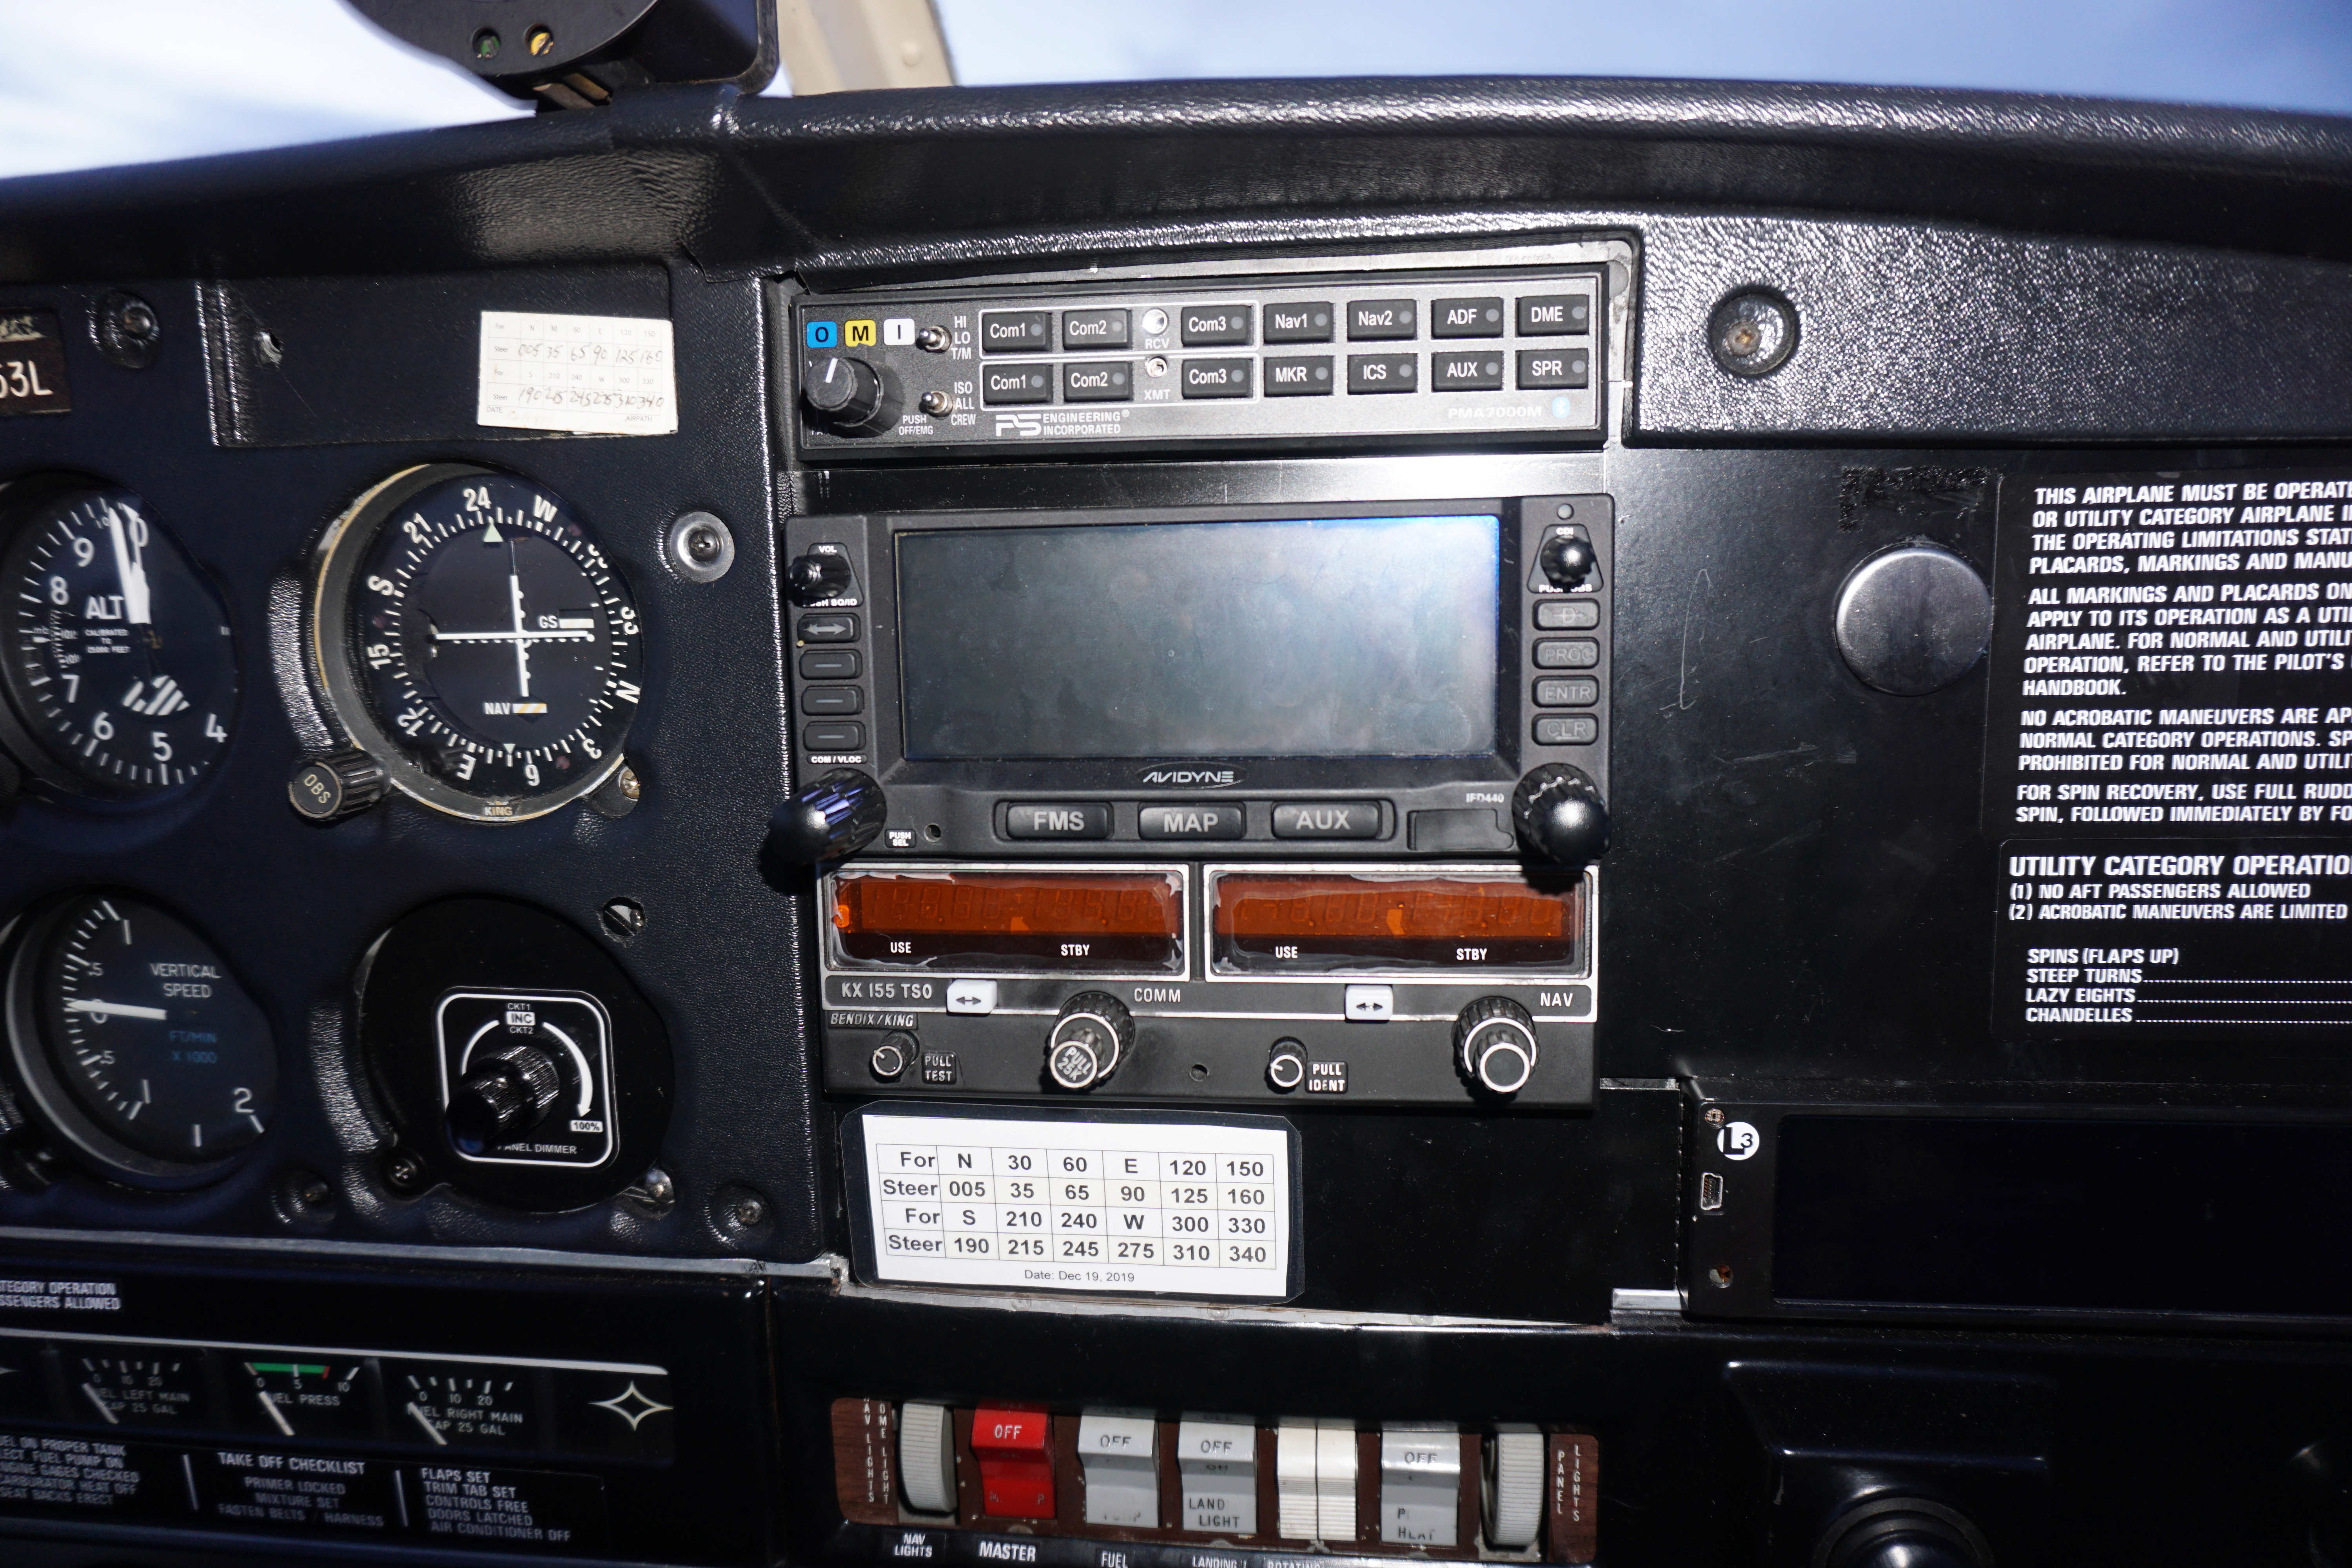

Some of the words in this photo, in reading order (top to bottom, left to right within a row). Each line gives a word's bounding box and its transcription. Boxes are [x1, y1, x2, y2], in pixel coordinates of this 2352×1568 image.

[1275, 314, 1307, 328] Nav1
[1358, 310, 1392, 326] Nav2
[1447, 309, 1477, 325] ADF
[1531, 307, 1563, 322] DME
[954, 317, 967, 328] HI
[1069, 320, 1106, 336] Com2
[1188, 317, 1227, 332] Com3
[815, 327, 829, 342] O
[852, 326, 869, 341] M
[898, 325, 901, 339] I
[955, 332, 970, 343] LO
[990, 323, 1026, 338] Com1
[1145, 338, 1170, 349] RCV
[951, 348, 971, 360] T/M
[1275, 367, 1307, 382] MKR
[1363, 365, 1387, 380] ICS
[1447, 361, 1477, 377] AUX
[1532, 361, 1562, 376] SPR
[991, 375, 1027, 390] Com1
[1070, 372, 1108, 388] Com2
[1189, 368, 1227, 385] Com3
[954, 382, 973, 394] ISO
[1144, 389, 1171, 400] XMT
[955, 398, 974, 410] ALL
[902, 415, 926, 424] PUSH
[951, 414, 976, 425] CREW
[1448, 406, 1541, 419] PMA7000M
[898, 426, 933, 435] OFF/EMG
[1043, 424, 1120, 436] INCORPORATED
[463, 487, 491, 512] 24
[2035, 488, 2076, 505] THIS
[2082, 485, 2174, 505] AIRPLANE
[2181, 485, 2238, 501] MUST
[2243, 483, 2268, 500] BE
[403, 513, 432, 543] 21
[73, 537, 94, 567] 9
[86, 595, 124, 619] ALT
[539, 616, 557, 627] GS
[1545, 648, 1594, 661] PROC
[1545, 687, 1591, 700] ENTR
[485, 703, 510, 715] NAV
[1547, 723, 1586, 735] CLR
[1143, 771, 1234, 782] AVIDYNE
[304, 774, 331, 804] OBS
[2017, 785, 2051, 800] FOR
[2057, 785, 2099, 800] SPIN
[2107, 785, 2204, 801] RECOVERY,
[2211, 784, 2247, 799] USE
[2254, 784, 2297, 799] FULL
[1466, 793, 1504, 802] IFD440
[485, 807, 512, 816] KING
[1034, 811, 1084, 831] FMS
[1164, 813, 1218, 832] MAP
[1296, 810, 1350, 829] AUX
[2009, 857, 2096, 876] UTILITY
[2104, 856, 2225, 875] CATEGORY
[2010, 884, 2032, 900] (1)
[2038, 884, 2063, 898] NO
[2069, 884, 2102, 898] AFT
[2108, 884, 2221, 898] PASSENGERS
[2227, 883, 2311, 898] ALLOWED
[890, 942, 911, 953] USE
[1061, 945, 1089, 956] STBY
[1275, 947, 1298, 958] USE
[1456, 948, 1487, 961] STBY
[150, 963, 221, 978] VERTICAL
[2027, 969, 2078, 983] STEEP
[2086, 969, 2142, 983] TURNS
[163, 984, 211, 998] SPEED
[842, 983, 862, 998] KX
[869, 984, 894, 998] 155
[901, 984, 932, 999] TSO
[1134, 988, 1181, 1003] COMM
[2025, 989, 2070, 1002] LAZY
[2076, 989, 2136, 1002] EIGHTS
[1540, 992, 1573, 1007] NAV
[510, 1013, 532, 1024] INC
[2025, 1008, 2132, 1022] CHANDELLES
[925, 1055, 951, 1067] PULL
[1064, 1046, 1090, 1075] PULL
[925, 1070, 951, 1082] TEST
[1057, 1058, 1080, 1081] 25K
[1312, 1064, 1341, 1076] PULL
[1309, 1079, 1345, 1091] IDENT
[573, 1122, 600, 1131] 100%
[901, 1151, 935, 1169] For
[958, 1154, 971, 1169] N
[1008, 1155, 1032, 1170] 30
[1063, 1156, 1087, 1172] 60
[1125, 1158, 1138, 1173] E
[1170, 1160, 1207, 1176] 120
[1227, 1161, 1263, 1177] 150
[883, 1180, 938, 1198] Steer
[949, 1181, 985, 1198] 005
[1010, 1183, 1034, 1199] 35
[1065, 1184, 1089, 1201] 65
[1120, 1186, 1145, 1202] 90
[1171, 1187, 1208, 1204] 125
[1227, 1189, 1265, 1205] 160
[906, 1208, 940, 1225] For
[963, 1210, 976, 1226] S
[1006, 1211, 1042, 1228] 210
[1061, 1212, 1097, 1229] 240
[1123, 1215, 1144, 1230] W
[1172, 1216, 1209, 1233] 300
[1228, 1218, 1266, 1234] 330
[889, 1235, 942, 1253] Steer
[954, 1238, 990, 1254] 190
[1008, 1239, 1044, 1256] 215
[1063, 1241, 1099, 1258] 245
[1118, 1242, 1154, 1259] 275
[1172, 1244, 1210, 1261] 310
[1229, 1246, 1266, 1263] 340
[1024, 1270, 1054, 1281] Date:
[1058, 1270, 1082, 1281] Dec
[1085, 1271, 1102, 1284] 19,
[1106, 1272, 1134, 1283] 2019
[995, 1424, 1022, 1439] OFF
[1100, 1435, 1131, 1448] OFF
[1201, 1440, 1232, 1454] OFF
[217, 1452, 253, 1466] TAKE
[259, 1455, 284, 1468] OFF
[289, 1457, 365, 1474] CHECKLIST
[421, 1468, 461, 1481] FLAPS
[467, 1471, 490, 1483] SET
[1189, 1498, 1225, 1510] LAND
[1199, 1515, 1240, 1527] LIGHT
[904, 1534, 926, 1544] NAV
[894, 1545, 932, 1557] LIGHTS
[980, 1541, 1036, 1562] MASTER
